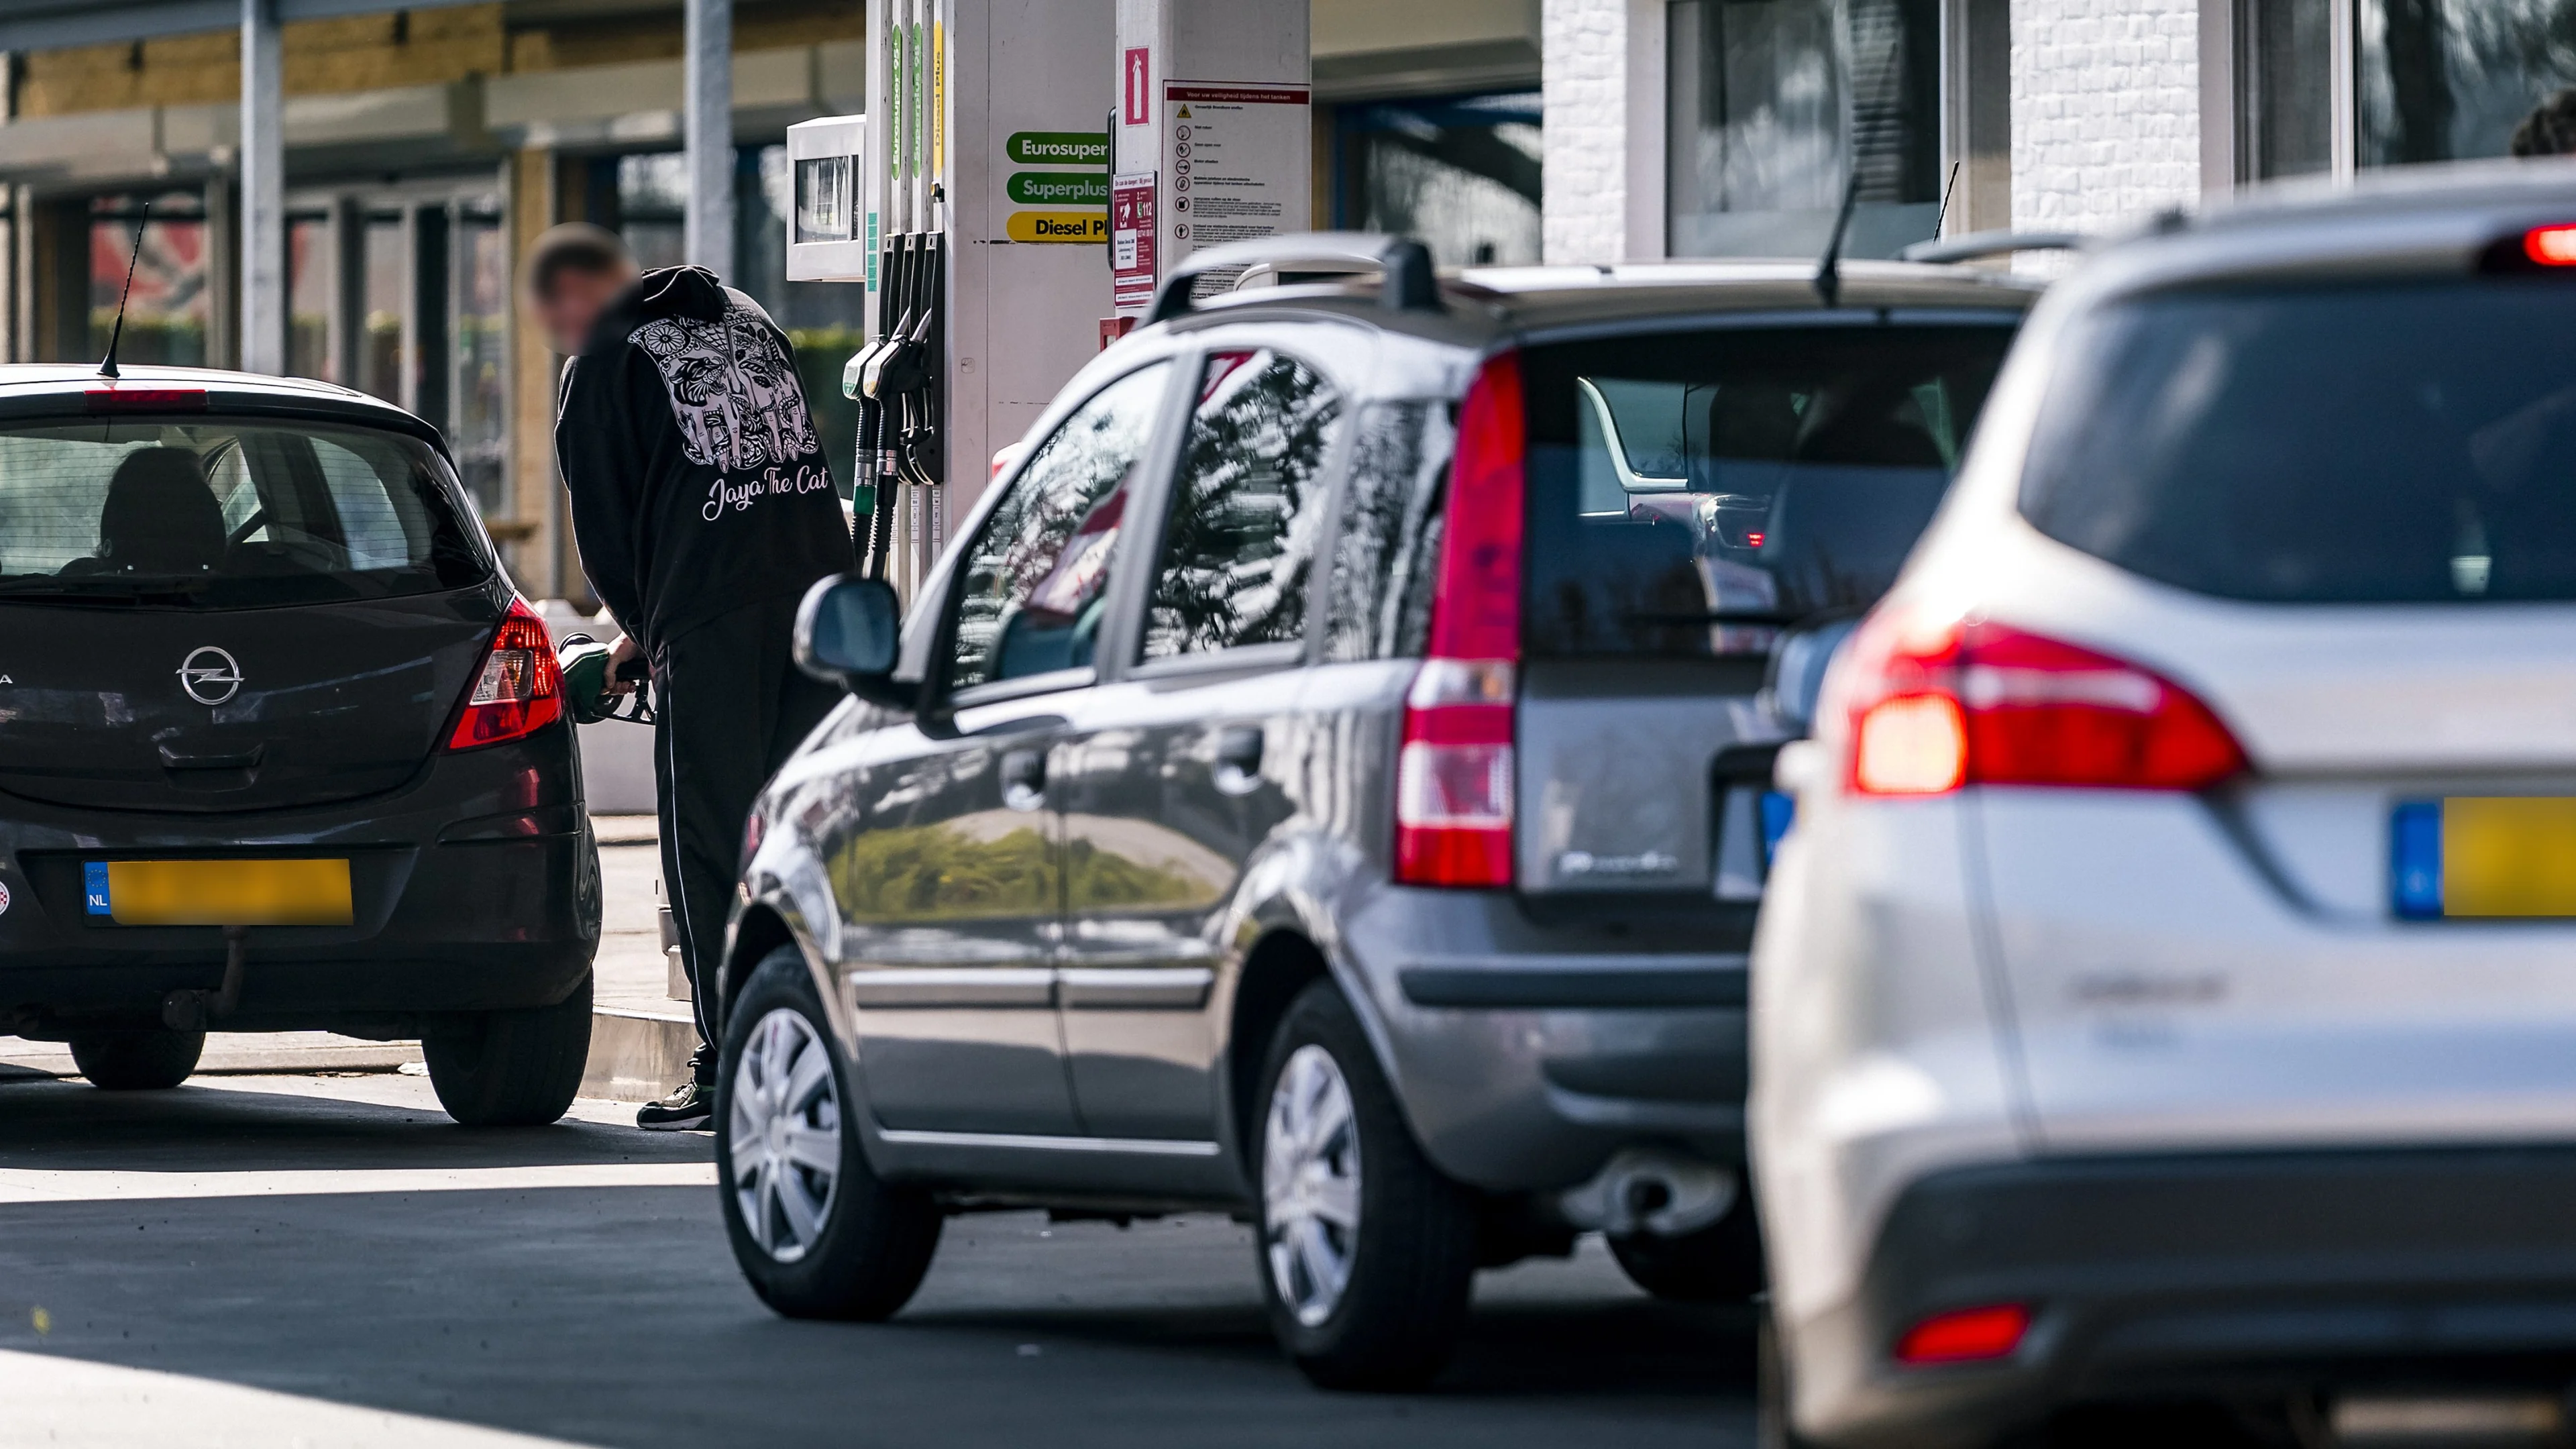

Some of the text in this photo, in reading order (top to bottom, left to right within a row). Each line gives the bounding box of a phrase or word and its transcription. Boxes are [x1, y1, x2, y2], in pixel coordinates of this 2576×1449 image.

[914, 44, 920, 67] 98
[1022, 140, 1108, 160] Eurosuper
[1023, 180, 1108, 200] Superplus
[1142, 201, 1152, 216] 112
[1036, 219, 1086, 235] Diesel
[702, 466, 828, 521] Jaya The Cat
[89, 894, 108, 906] NL
